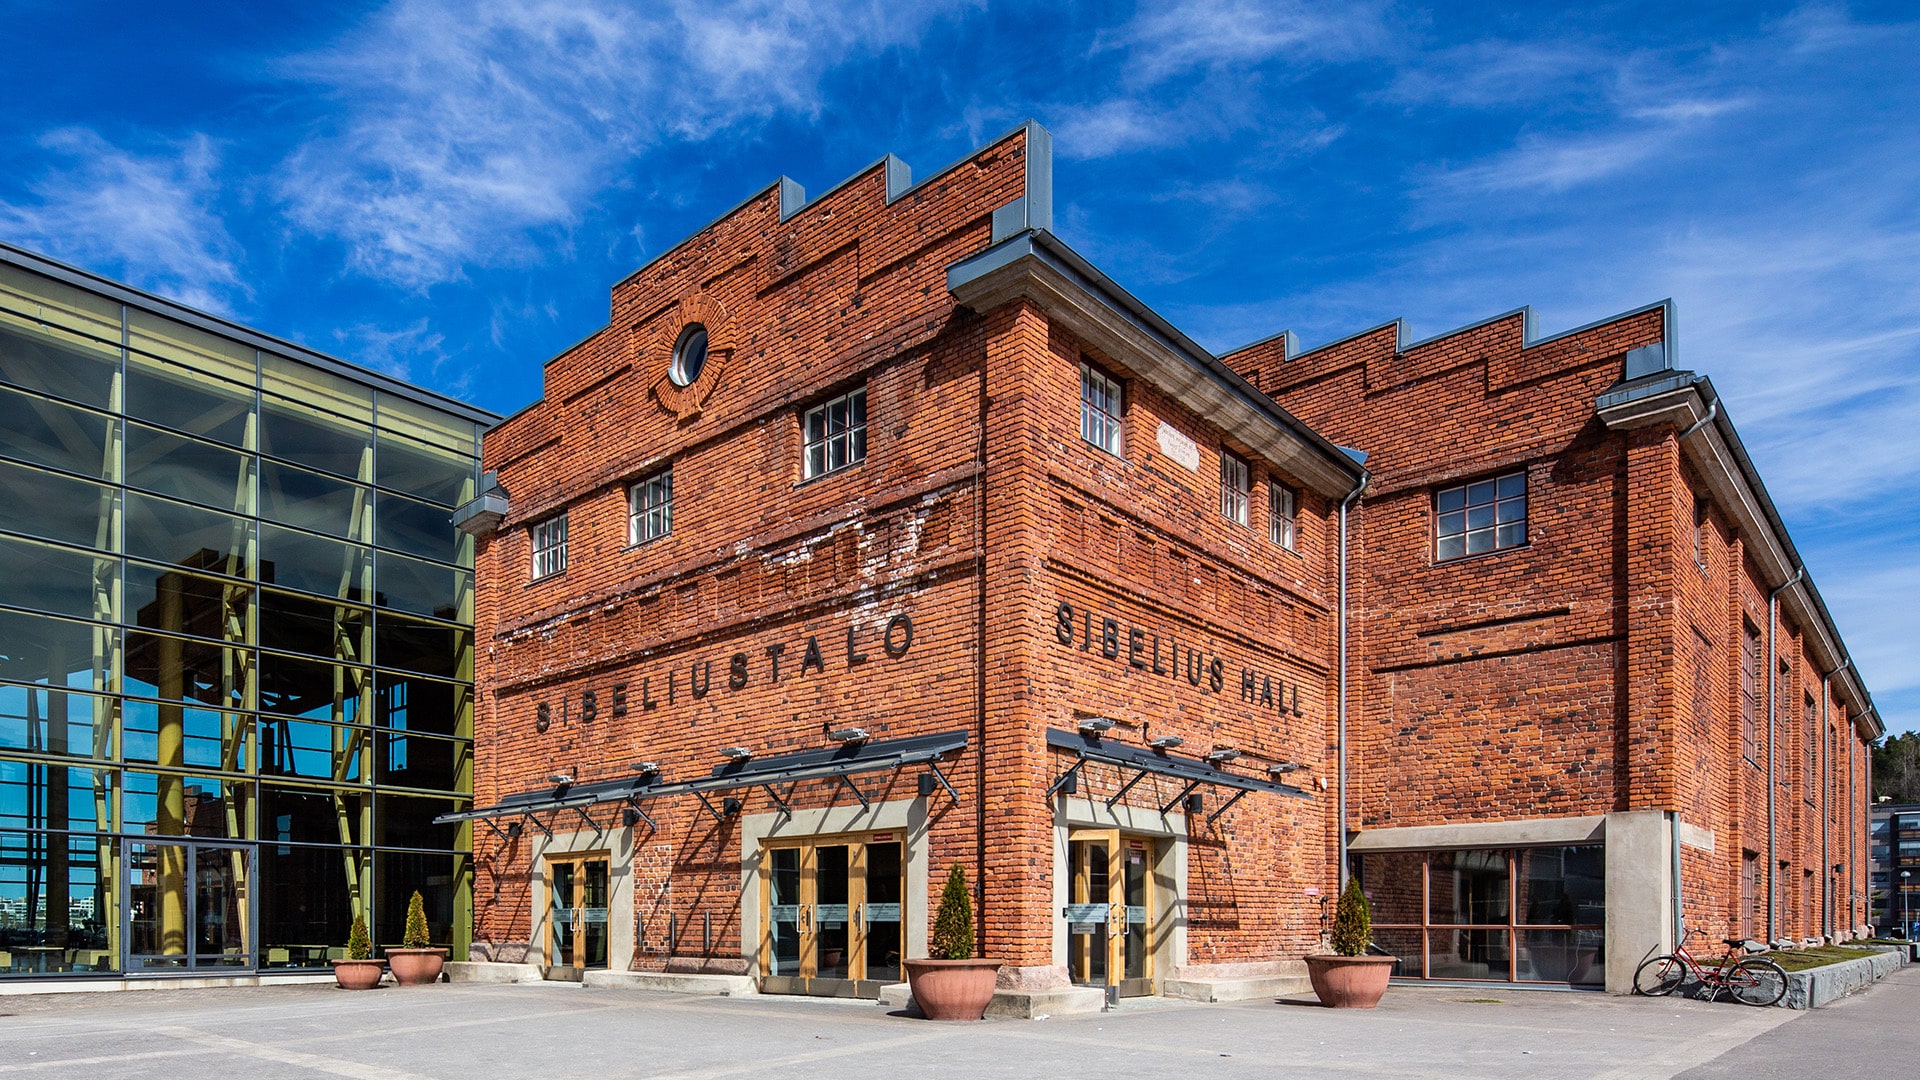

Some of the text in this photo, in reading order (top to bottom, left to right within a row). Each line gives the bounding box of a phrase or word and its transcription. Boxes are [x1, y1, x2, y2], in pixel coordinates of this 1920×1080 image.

[537, 613, 914, 733] SIBELIUSTALO
[1056, 602, 1303, 715] SIBELIUS HALL
